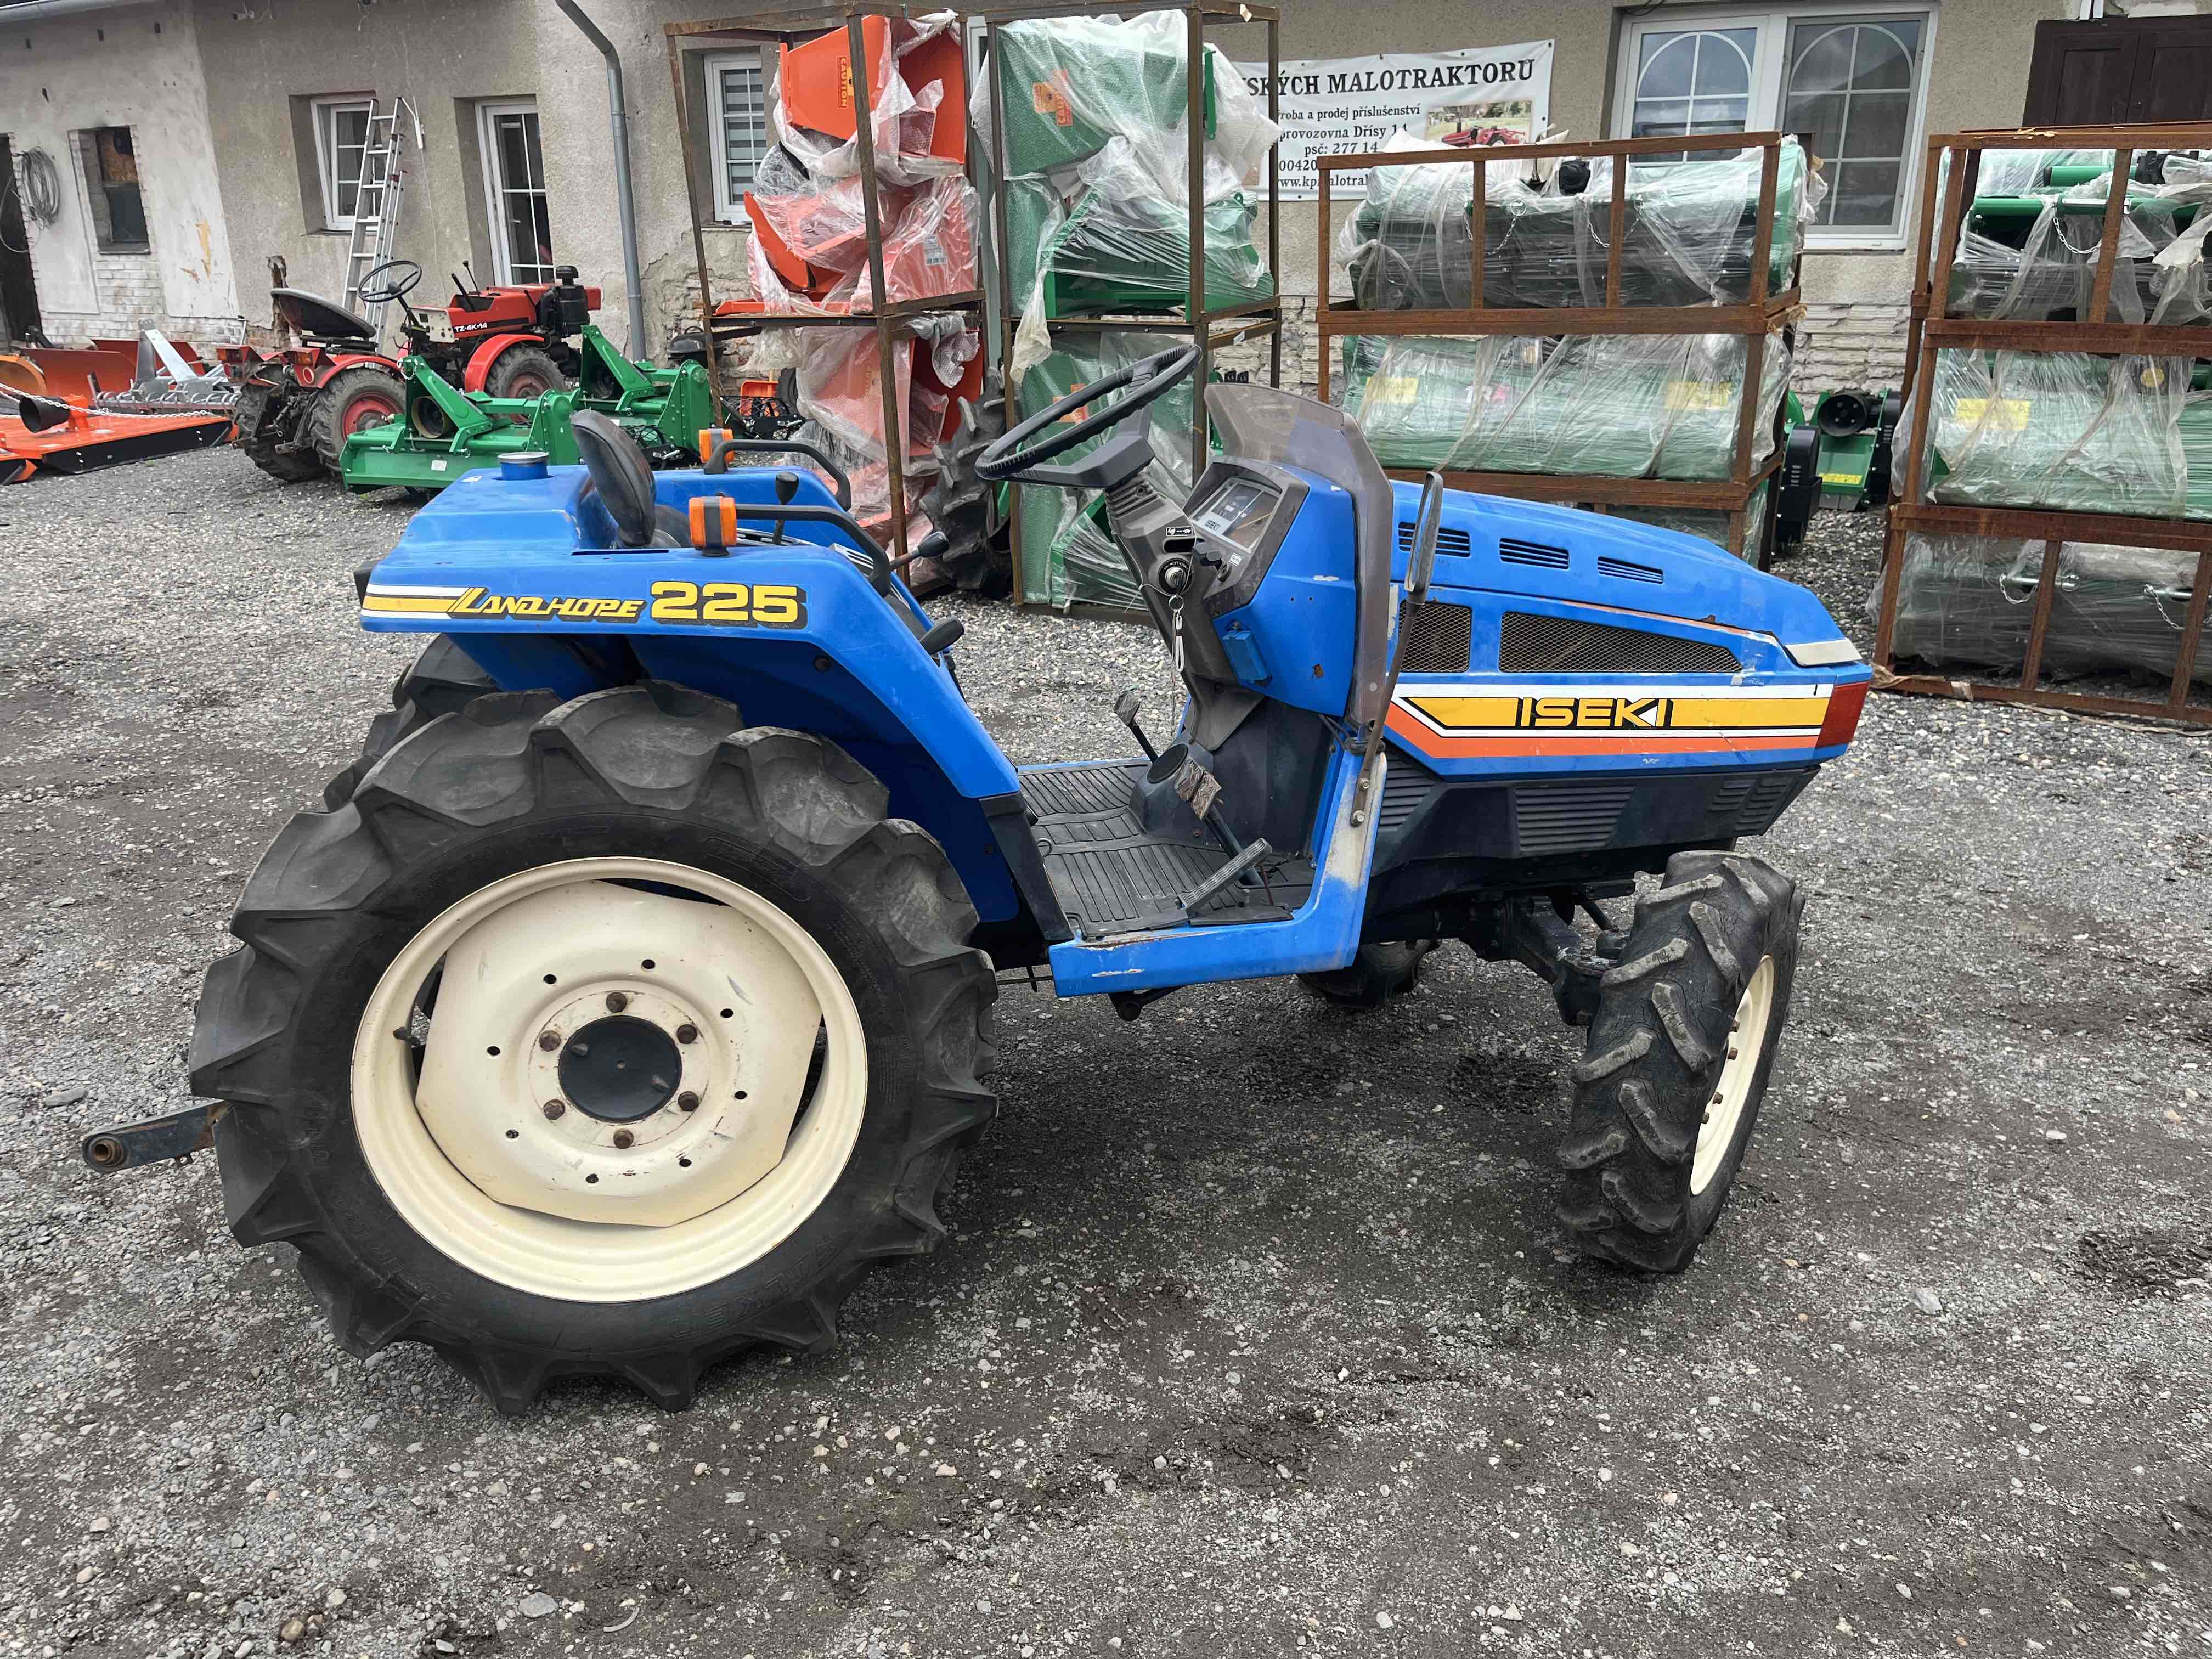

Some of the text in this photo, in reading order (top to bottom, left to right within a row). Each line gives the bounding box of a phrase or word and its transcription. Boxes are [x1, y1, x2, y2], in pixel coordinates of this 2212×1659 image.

[1242, 58, 1535, 96] SKÝCH MALOTRAKTORŮ
[1308, 111, 1314, 120] a
[1317, 107, 1349, 121] prodej
[1352, 103, 1421, 120] příslušenství
[1280, 128, 1349, 142] provozovna
[1353, 124, 1387, 139] Dřísy
[1305, 141, 1378, 157] psč: 277 14
[1279, 160, 1317, 171] 00420
[650, 580, 801, 625] 225
[1519, 697, 1669, 729] ISEKI
